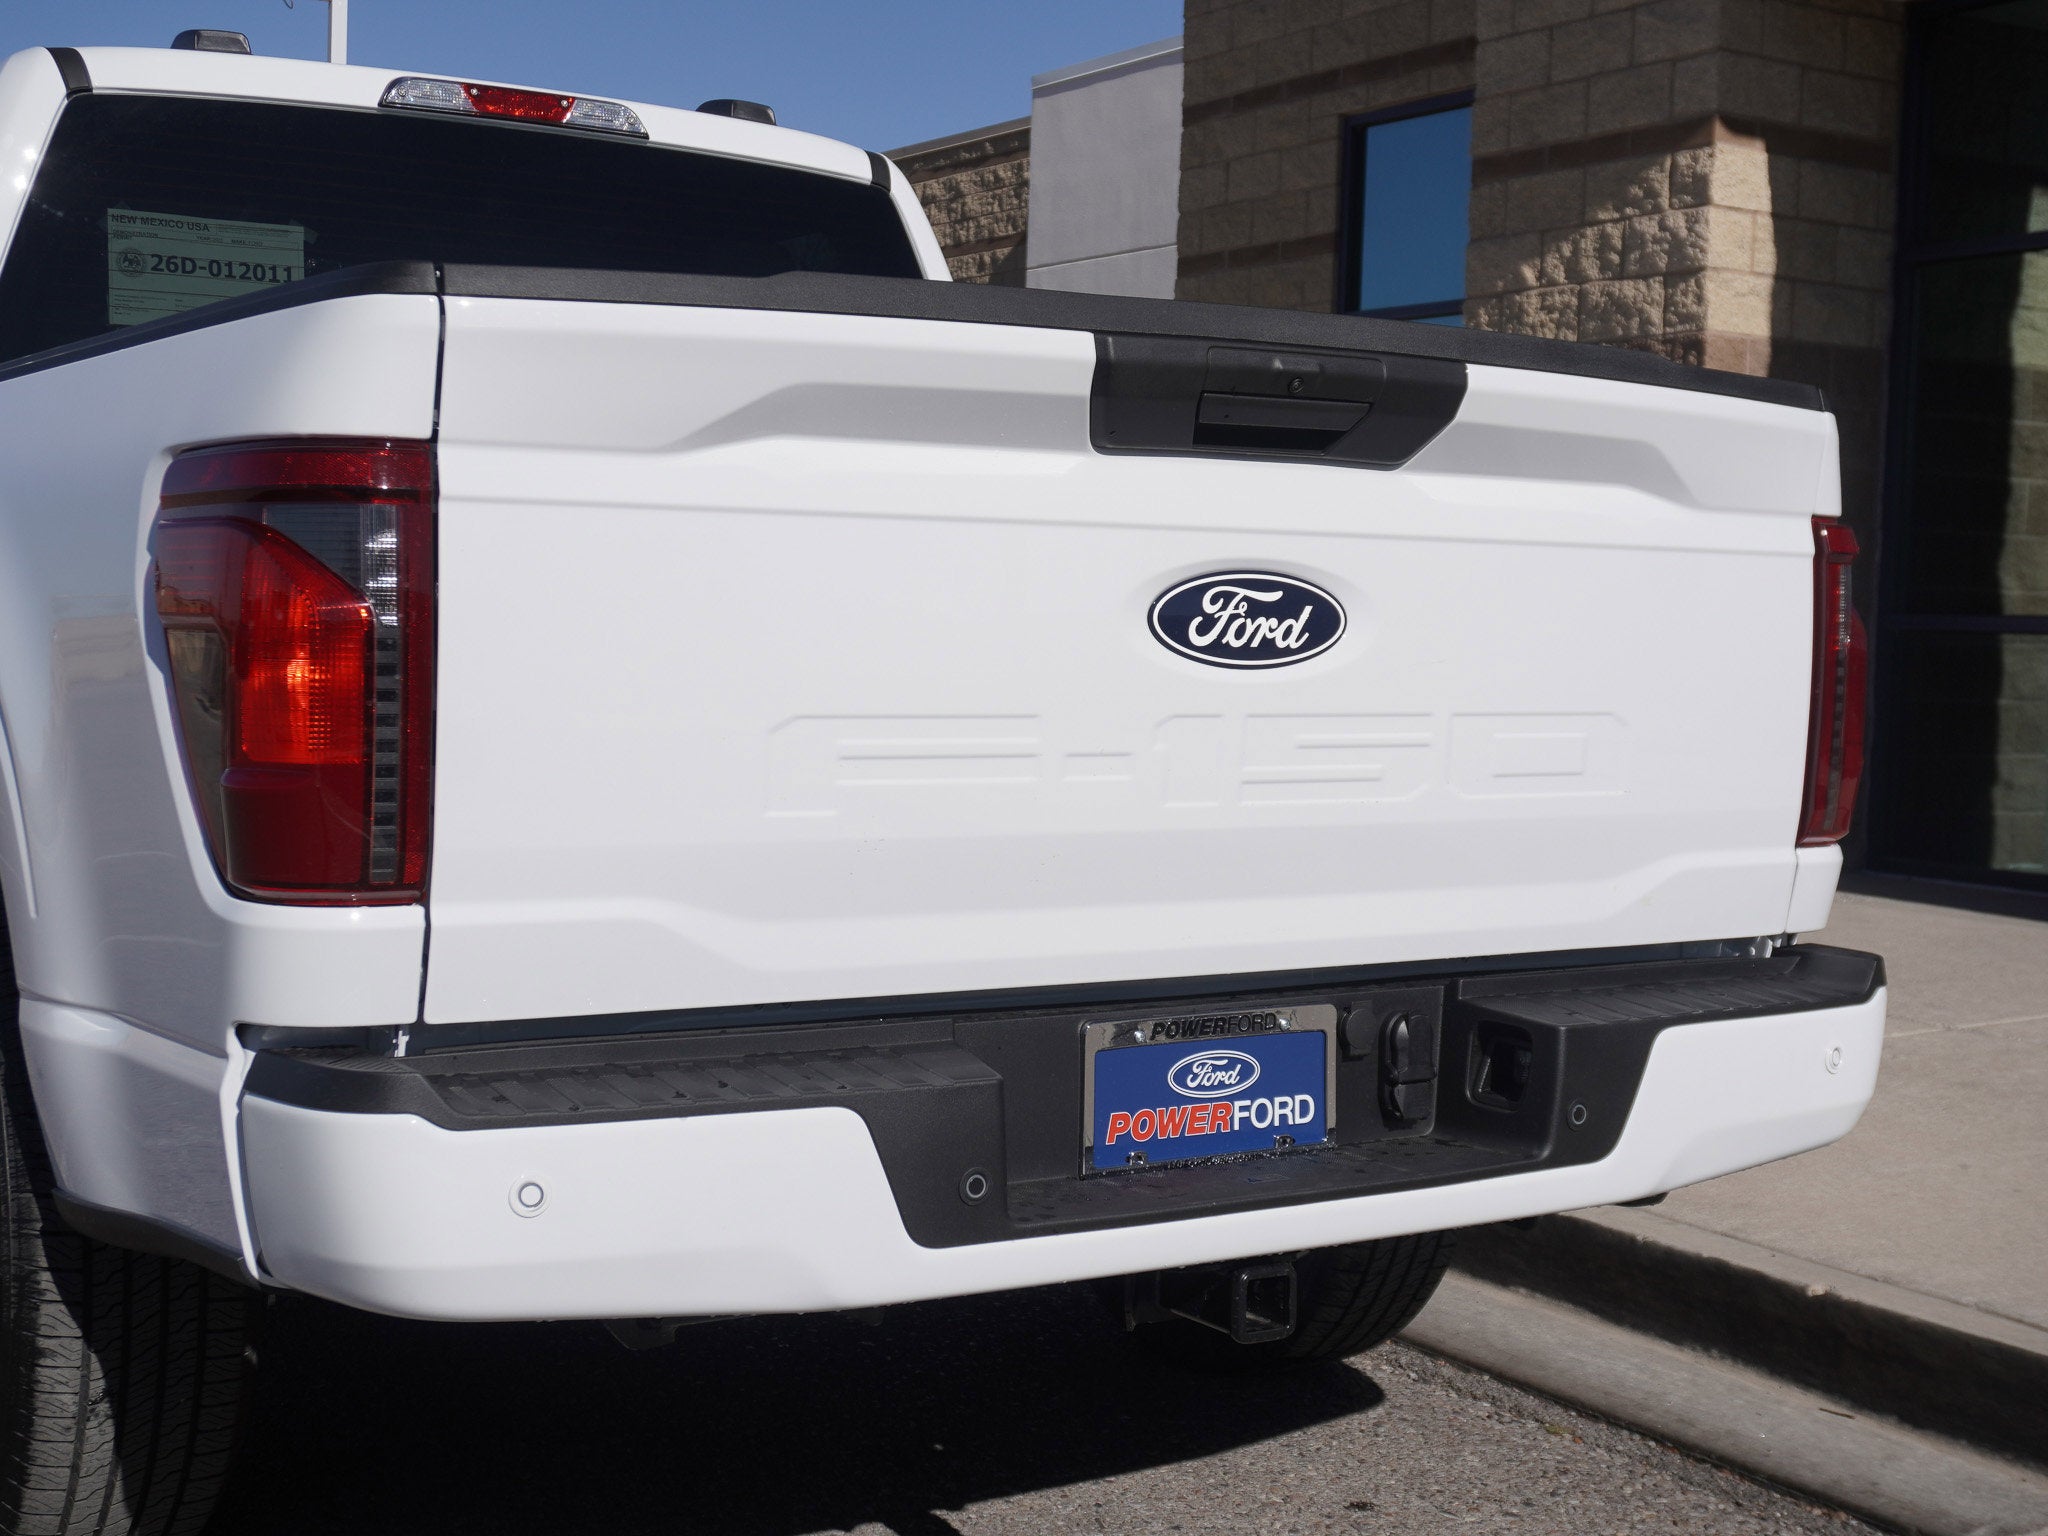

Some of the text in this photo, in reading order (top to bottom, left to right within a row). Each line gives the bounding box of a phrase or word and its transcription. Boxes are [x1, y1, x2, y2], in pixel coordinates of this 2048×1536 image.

[111, 213, 141, 226] NEW
[141, 216, 184, 231] MEXICO
[186, 221, 210, 232] USA
[150, 253, 293, 284] 26D-012011
[1188, 585, 1313, 649] Ford
[762, 712, 1632, 819] F-150
[1186, 1059, 1241, 1089] Ford
[1105, 1093, 1315, 1146] POWERFORD
